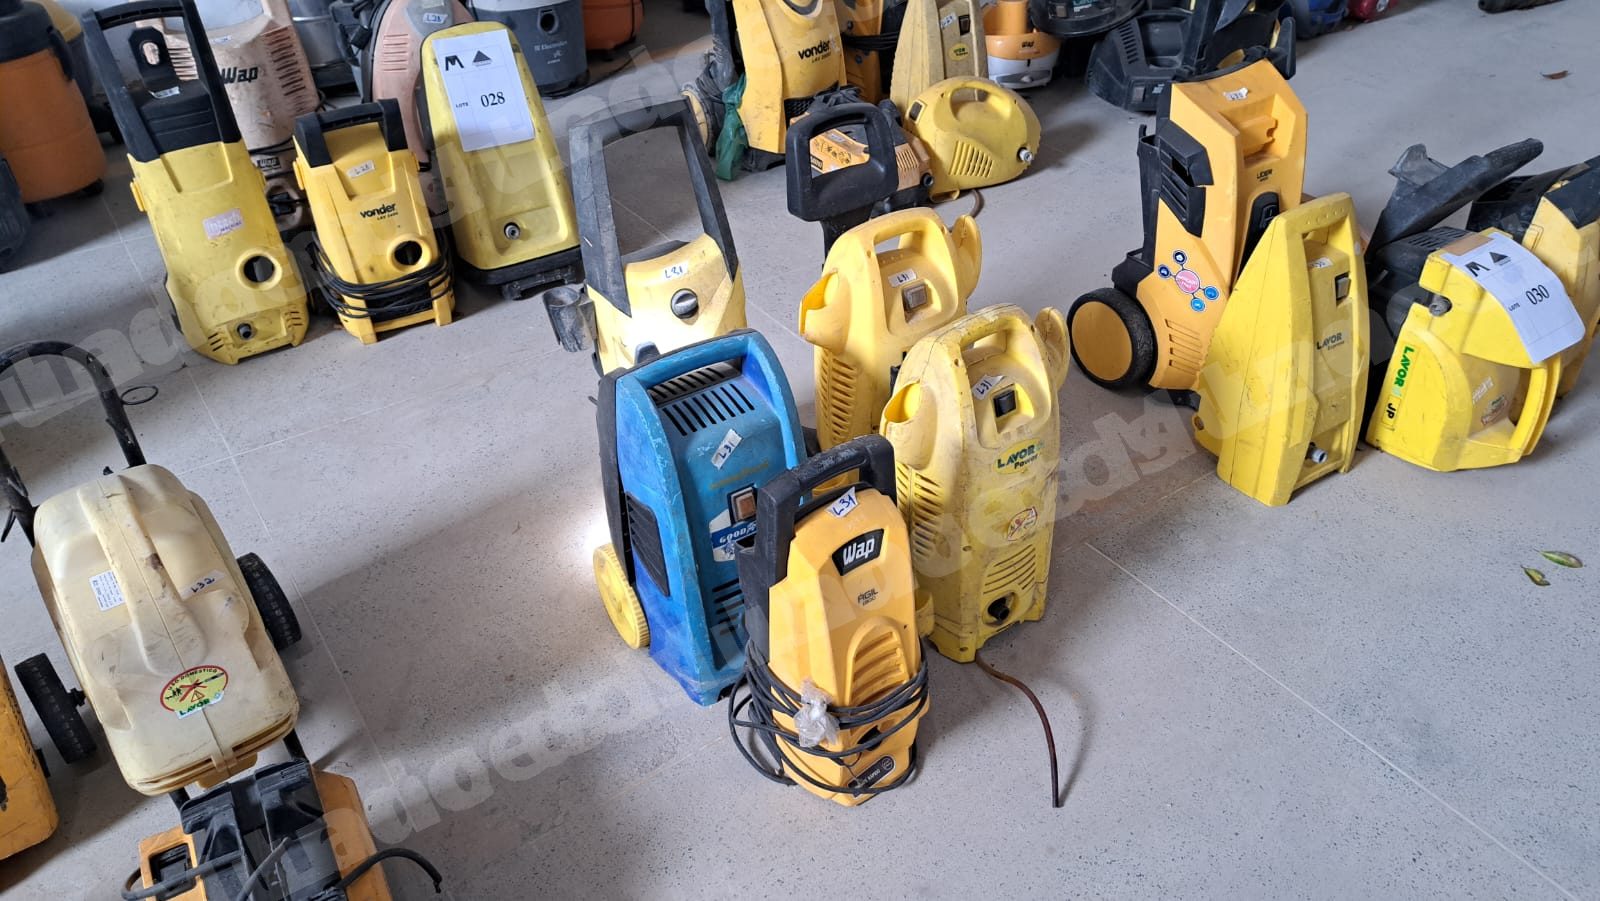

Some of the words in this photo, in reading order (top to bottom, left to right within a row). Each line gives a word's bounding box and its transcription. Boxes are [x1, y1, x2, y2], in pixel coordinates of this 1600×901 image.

[798, 40, 830, 60] vonder
[221, 66, 259, 84] Wap
[480, 91, 506, 107] 028
[360, 203, 396, 218] vonder
[1525, 284, 1550, 306] 030
[1316, 332, 1343, 350] LAVOR
[1394, 346, 1415, 387] LAVOR
[976, 379, 993, 395] L31
[1386, 403, 1397, 419] JP
[718, 440, 736, 460] L31
[998, 445, 1035, 469] LAVOR
[1013, 453, 1039, 469] Power
[832, 494, 857, 516] L31
[842, 537, 876, 566] Wap
[190, 577, 216, 594] L32
[179, 698, 211, 716] LAVOR
